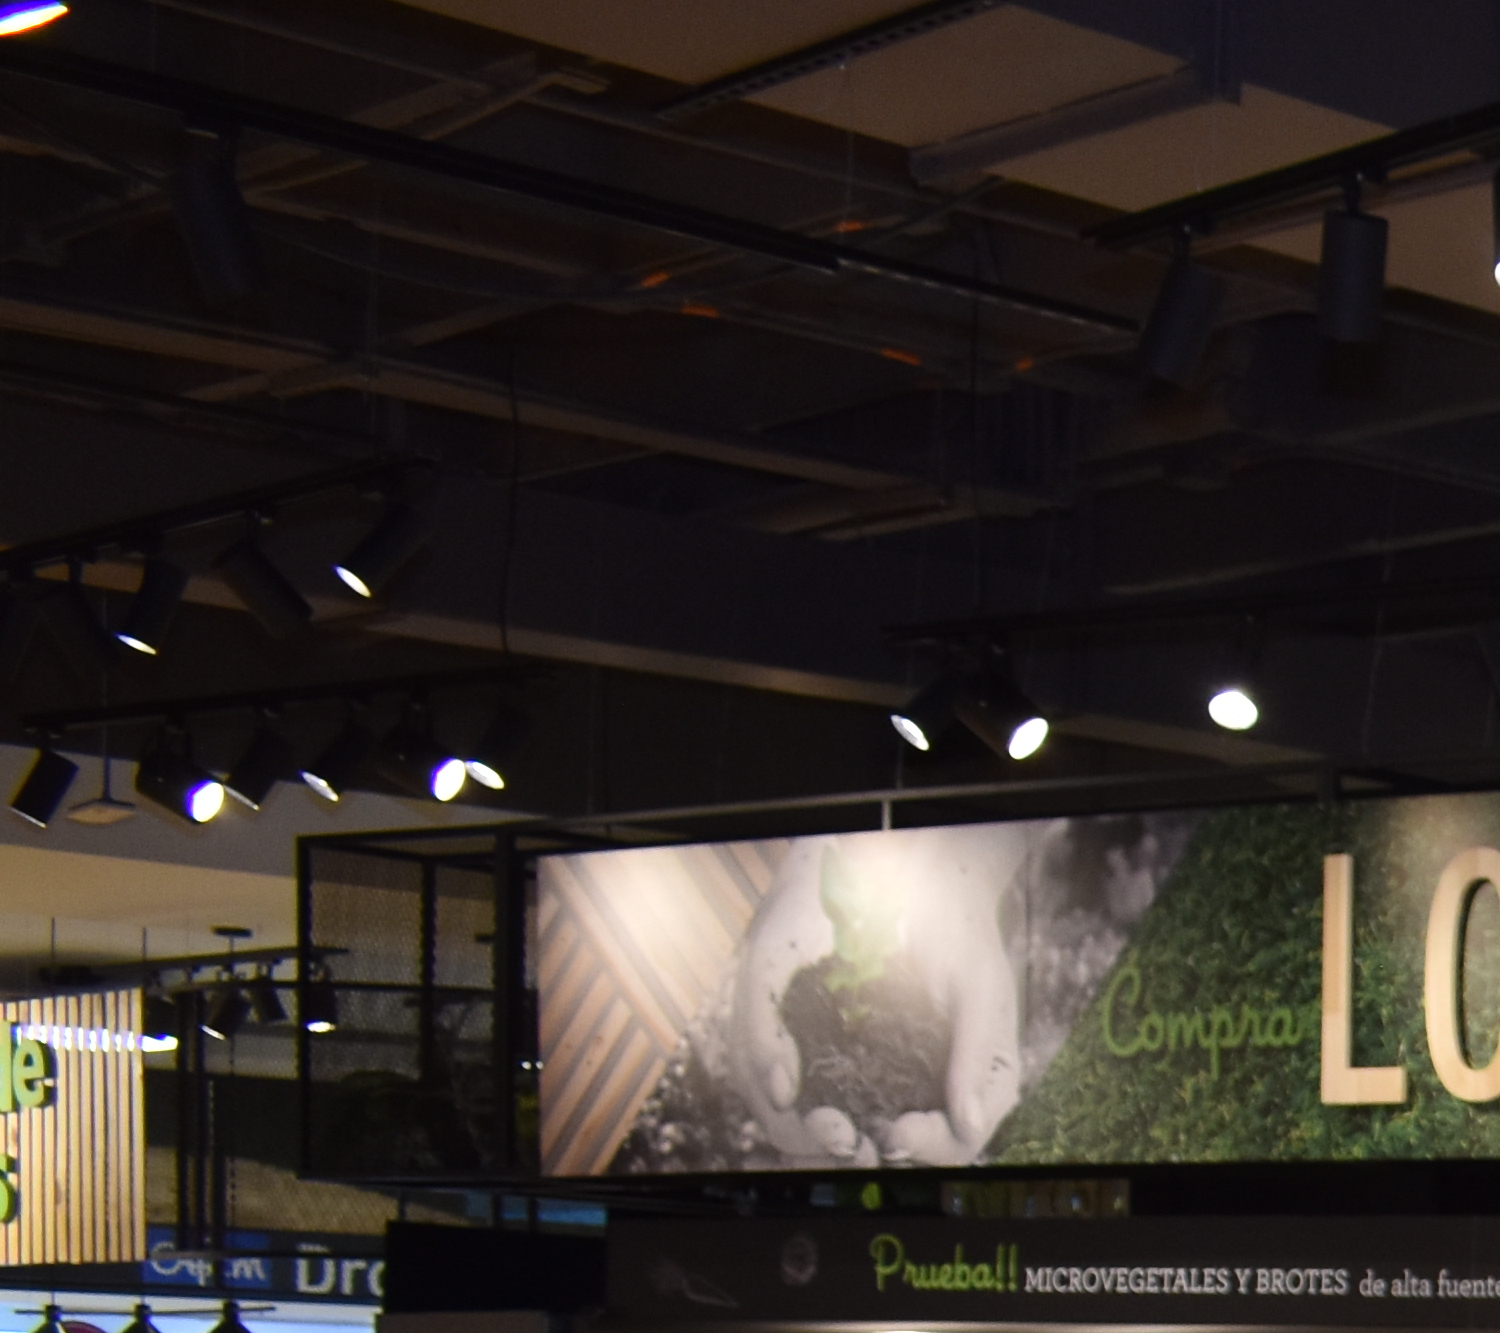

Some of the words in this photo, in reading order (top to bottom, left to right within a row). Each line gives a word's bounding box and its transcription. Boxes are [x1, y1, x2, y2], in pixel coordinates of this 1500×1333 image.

[1099, 962, 1305, 1077] Compra
[1023, 1264, 1231, 1297] MICROVEGETALES
[1235, 1267, 1253, 1296] Y
[1255, 1267, 1349, 1298] BROTES
[1358, 1269, 1387, 1298] de
[1390, 1269, 1433, 1299] alta
